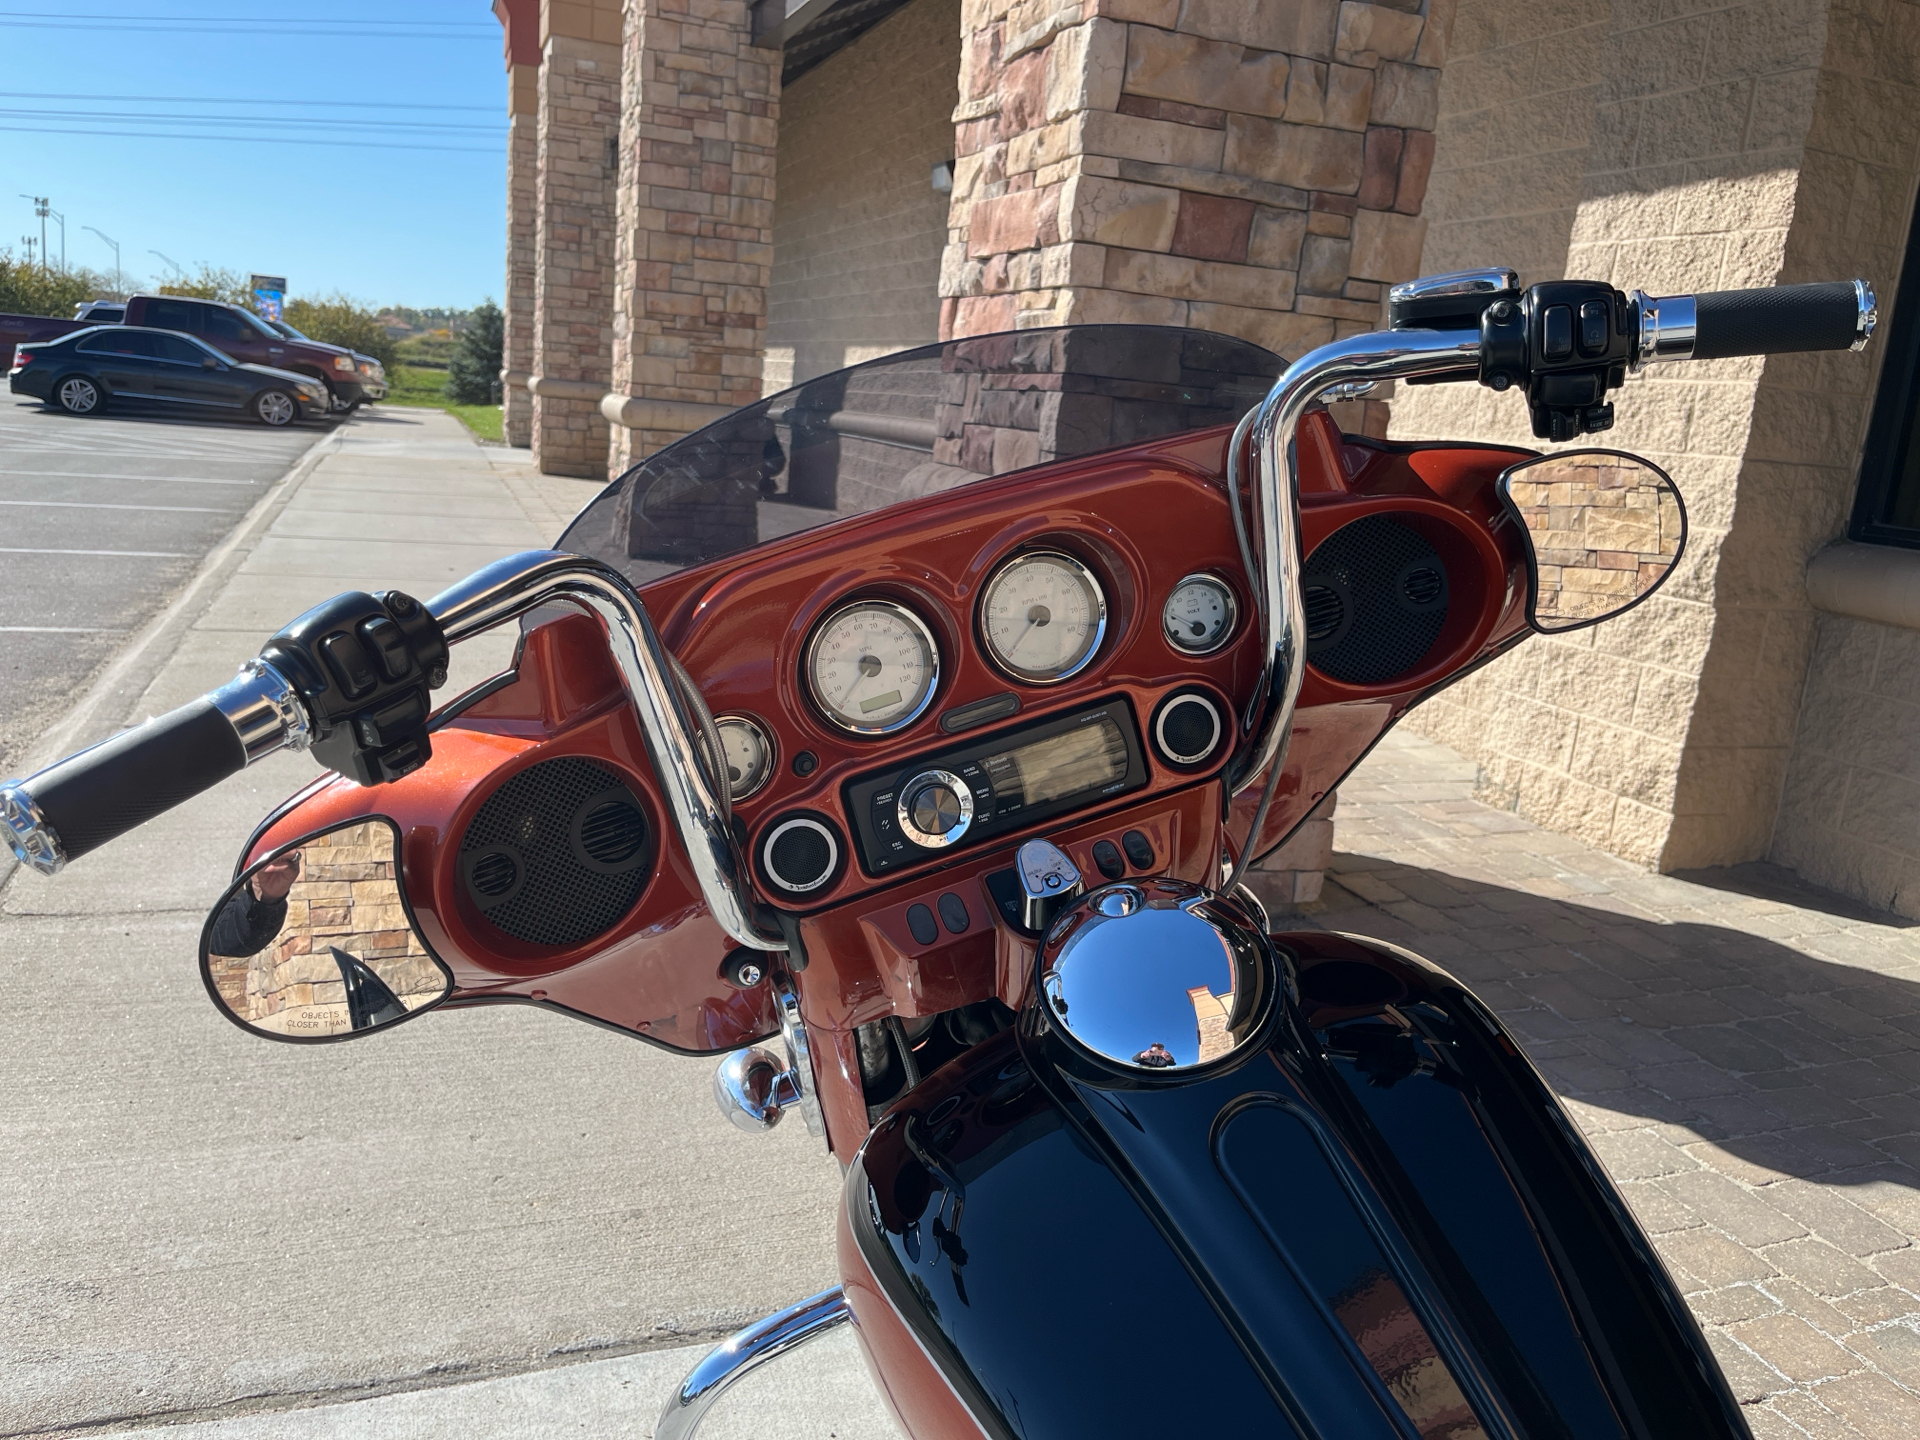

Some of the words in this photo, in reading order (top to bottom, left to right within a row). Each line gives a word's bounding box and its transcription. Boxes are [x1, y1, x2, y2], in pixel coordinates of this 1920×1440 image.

[1025, 575, 1034, 583] 40
[1045, 576, 1054, 584] 50
[1008, 587, 1017, 595] 30
[1061, 588, 1071, 596] 60
[854, 623, 863, 631] 60
[869, 622, 878, 630] 70
[883, 626, 892, 634] 80
[1067, 626, 1076, 634] 80
[841, 631, 851, 639] 50
[894, 635, 904, 643] 90
[831, 642, 841, 650] 40
[898, 647, 911, 656] 100
[827, 656, 836, 664] 30
[902, 662, 914, 670] 110
[827, 671, 837, 679] 20
[899, 675, 911, 683] 120
[833, 685, 842, 693] 10
[301, 1010, 340, 1019] OBJECTS
[286, 1019, 319, 1029] CLOSER
[324, 1018, 347, 1028] THAN
